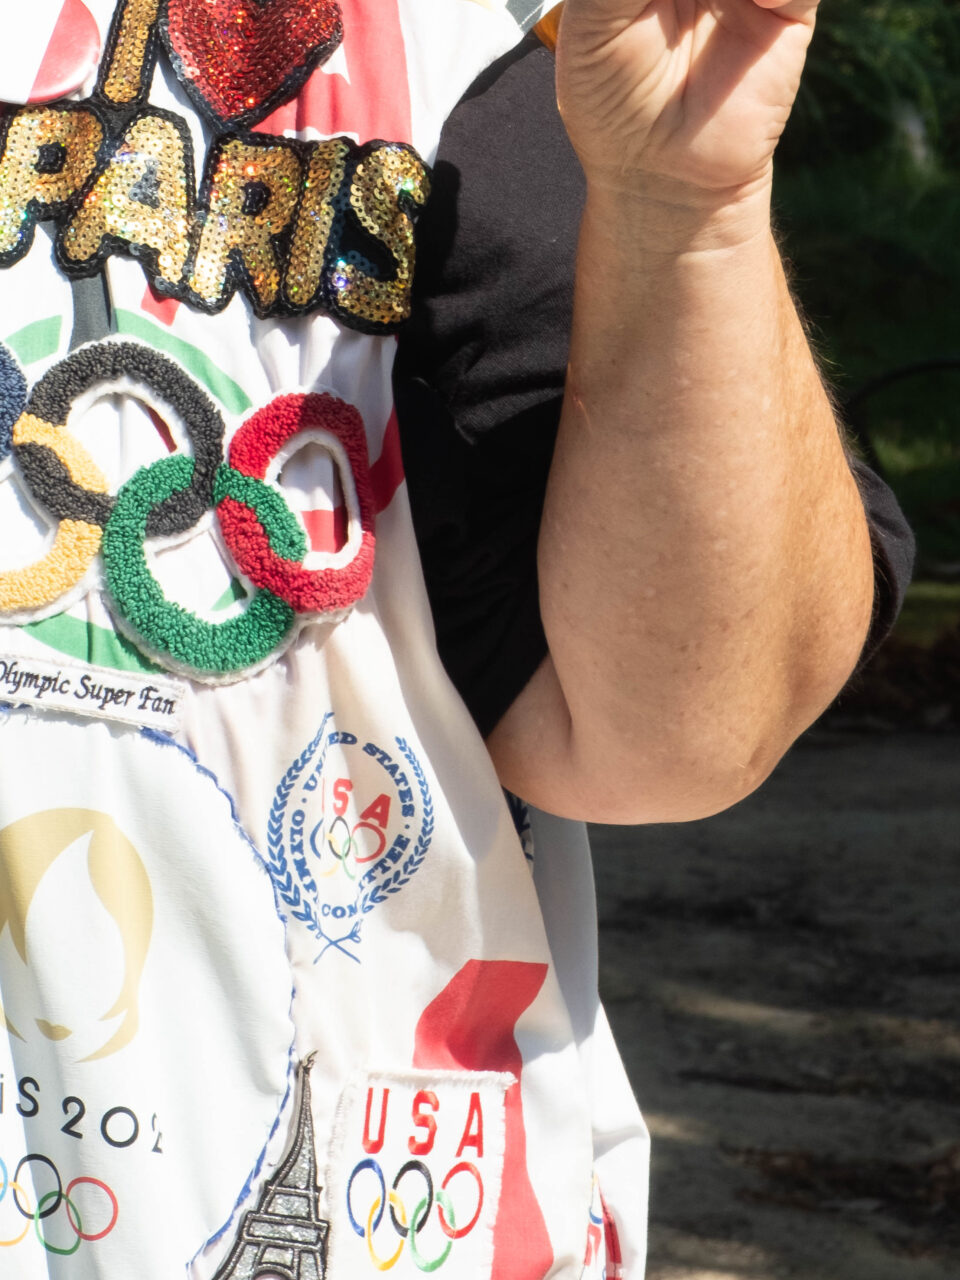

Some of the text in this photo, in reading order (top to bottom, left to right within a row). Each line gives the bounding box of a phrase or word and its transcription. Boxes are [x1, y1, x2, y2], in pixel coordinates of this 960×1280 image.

[73, 674, 135, 710] Super
[137, 685, 176, 715] Fan
[361, 742, 416, 818] STATES
[361, 1086, 485, 1159] USA
